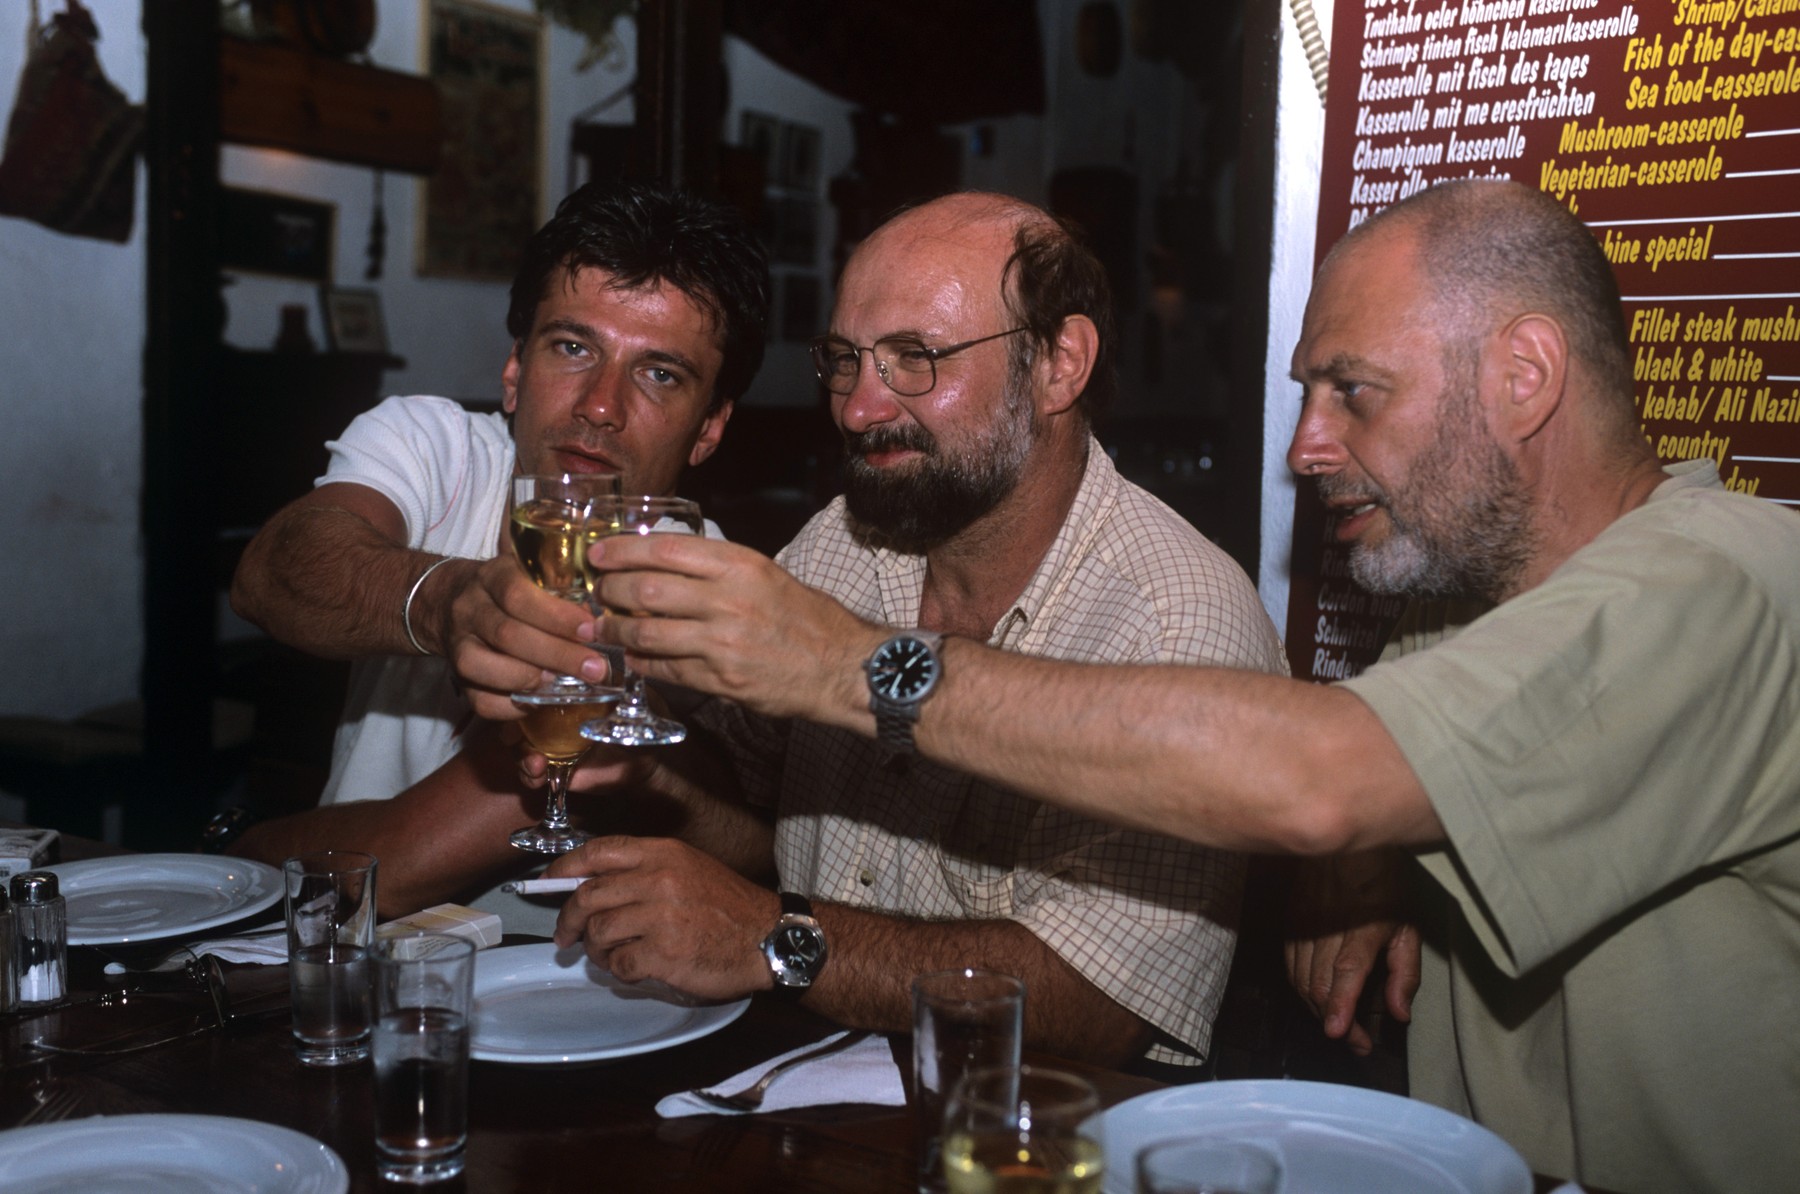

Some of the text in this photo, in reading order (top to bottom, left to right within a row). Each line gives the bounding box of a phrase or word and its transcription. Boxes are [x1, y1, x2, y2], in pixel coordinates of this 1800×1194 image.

[1674, 0, 1800, 31] Shrimp/Calam
[1360, 39, 1420, 72] Schrimps
[1422, 34, 1462, 61] tinten
[1464, 24, 1498, 56] fisch
[1623, 33, 1664, 72] Fish
[1667, 28, 1693, 67] of
[1693, 26, 1725, 64] the
[1358, 51, 1590, 102] Kasserolle mit fisch des tages
[1625, 56, 1800, 111] Sea food-casserole
[1355, 98, 1430, 136] Kasserolle
[1432, 96, 1462, 129] mit
[1558, 103, 1744, 155] Mushroom-casserole
[1352, 136, 1443, 176] Champignon
[1446, 125, 1526, 164] kasserolle
[1539, 145, 1723, 201] Vegetarian-casserole
[1644, 224, 1714, 273] special
[1629, 307, 1681, 343] Fillet
[1683, 305, 1737, 342] steak
[1633, 346, 1763, 382] black & white
[1714, 386, 1748, 423] Ali
[1657, 429, 1730, 472] country
